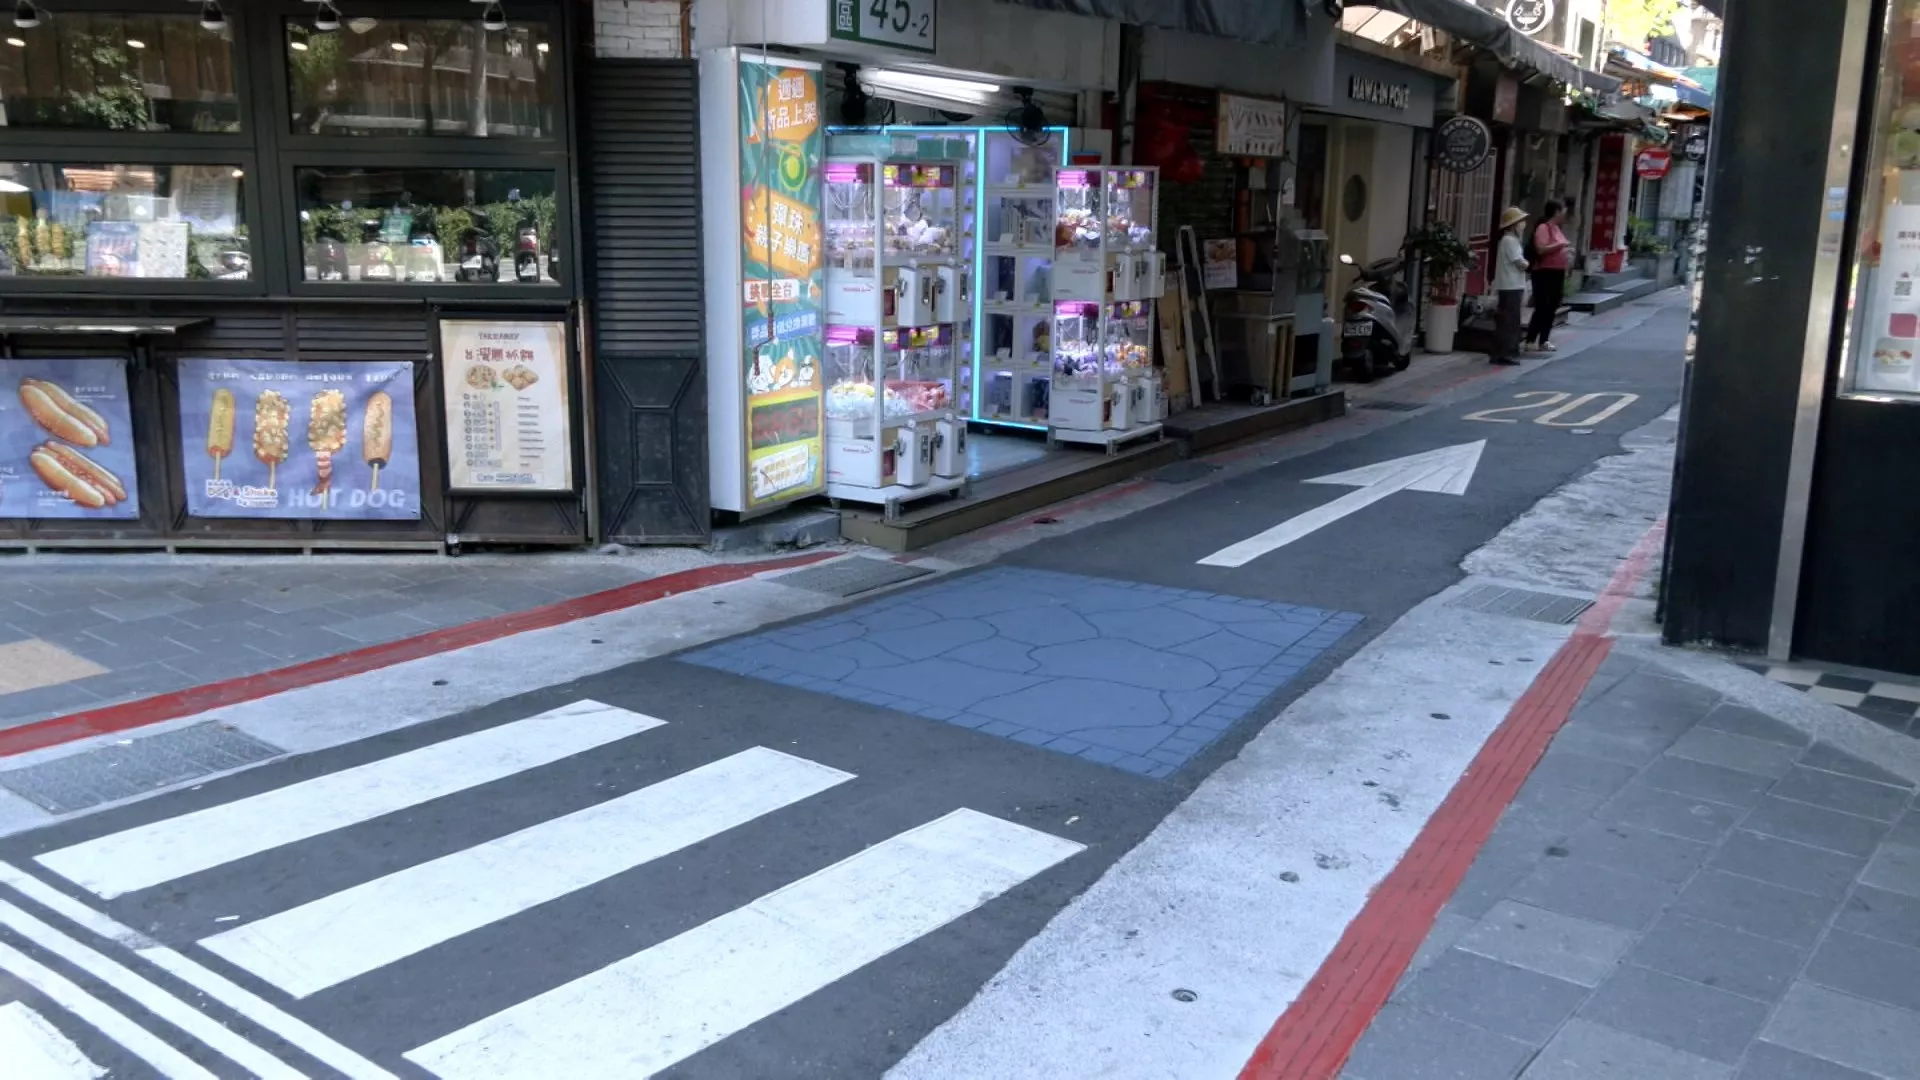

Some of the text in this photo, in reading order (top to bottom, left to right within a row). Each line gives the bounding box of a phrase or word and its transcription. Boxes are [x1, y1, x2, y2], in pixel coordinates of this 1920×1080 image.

[870, 0, 929, 37] 45-2
[1461, 390, 1641, 427] 20
[288, 488, 344, 509] HOT
[350, 488, 407, 508] DOG
